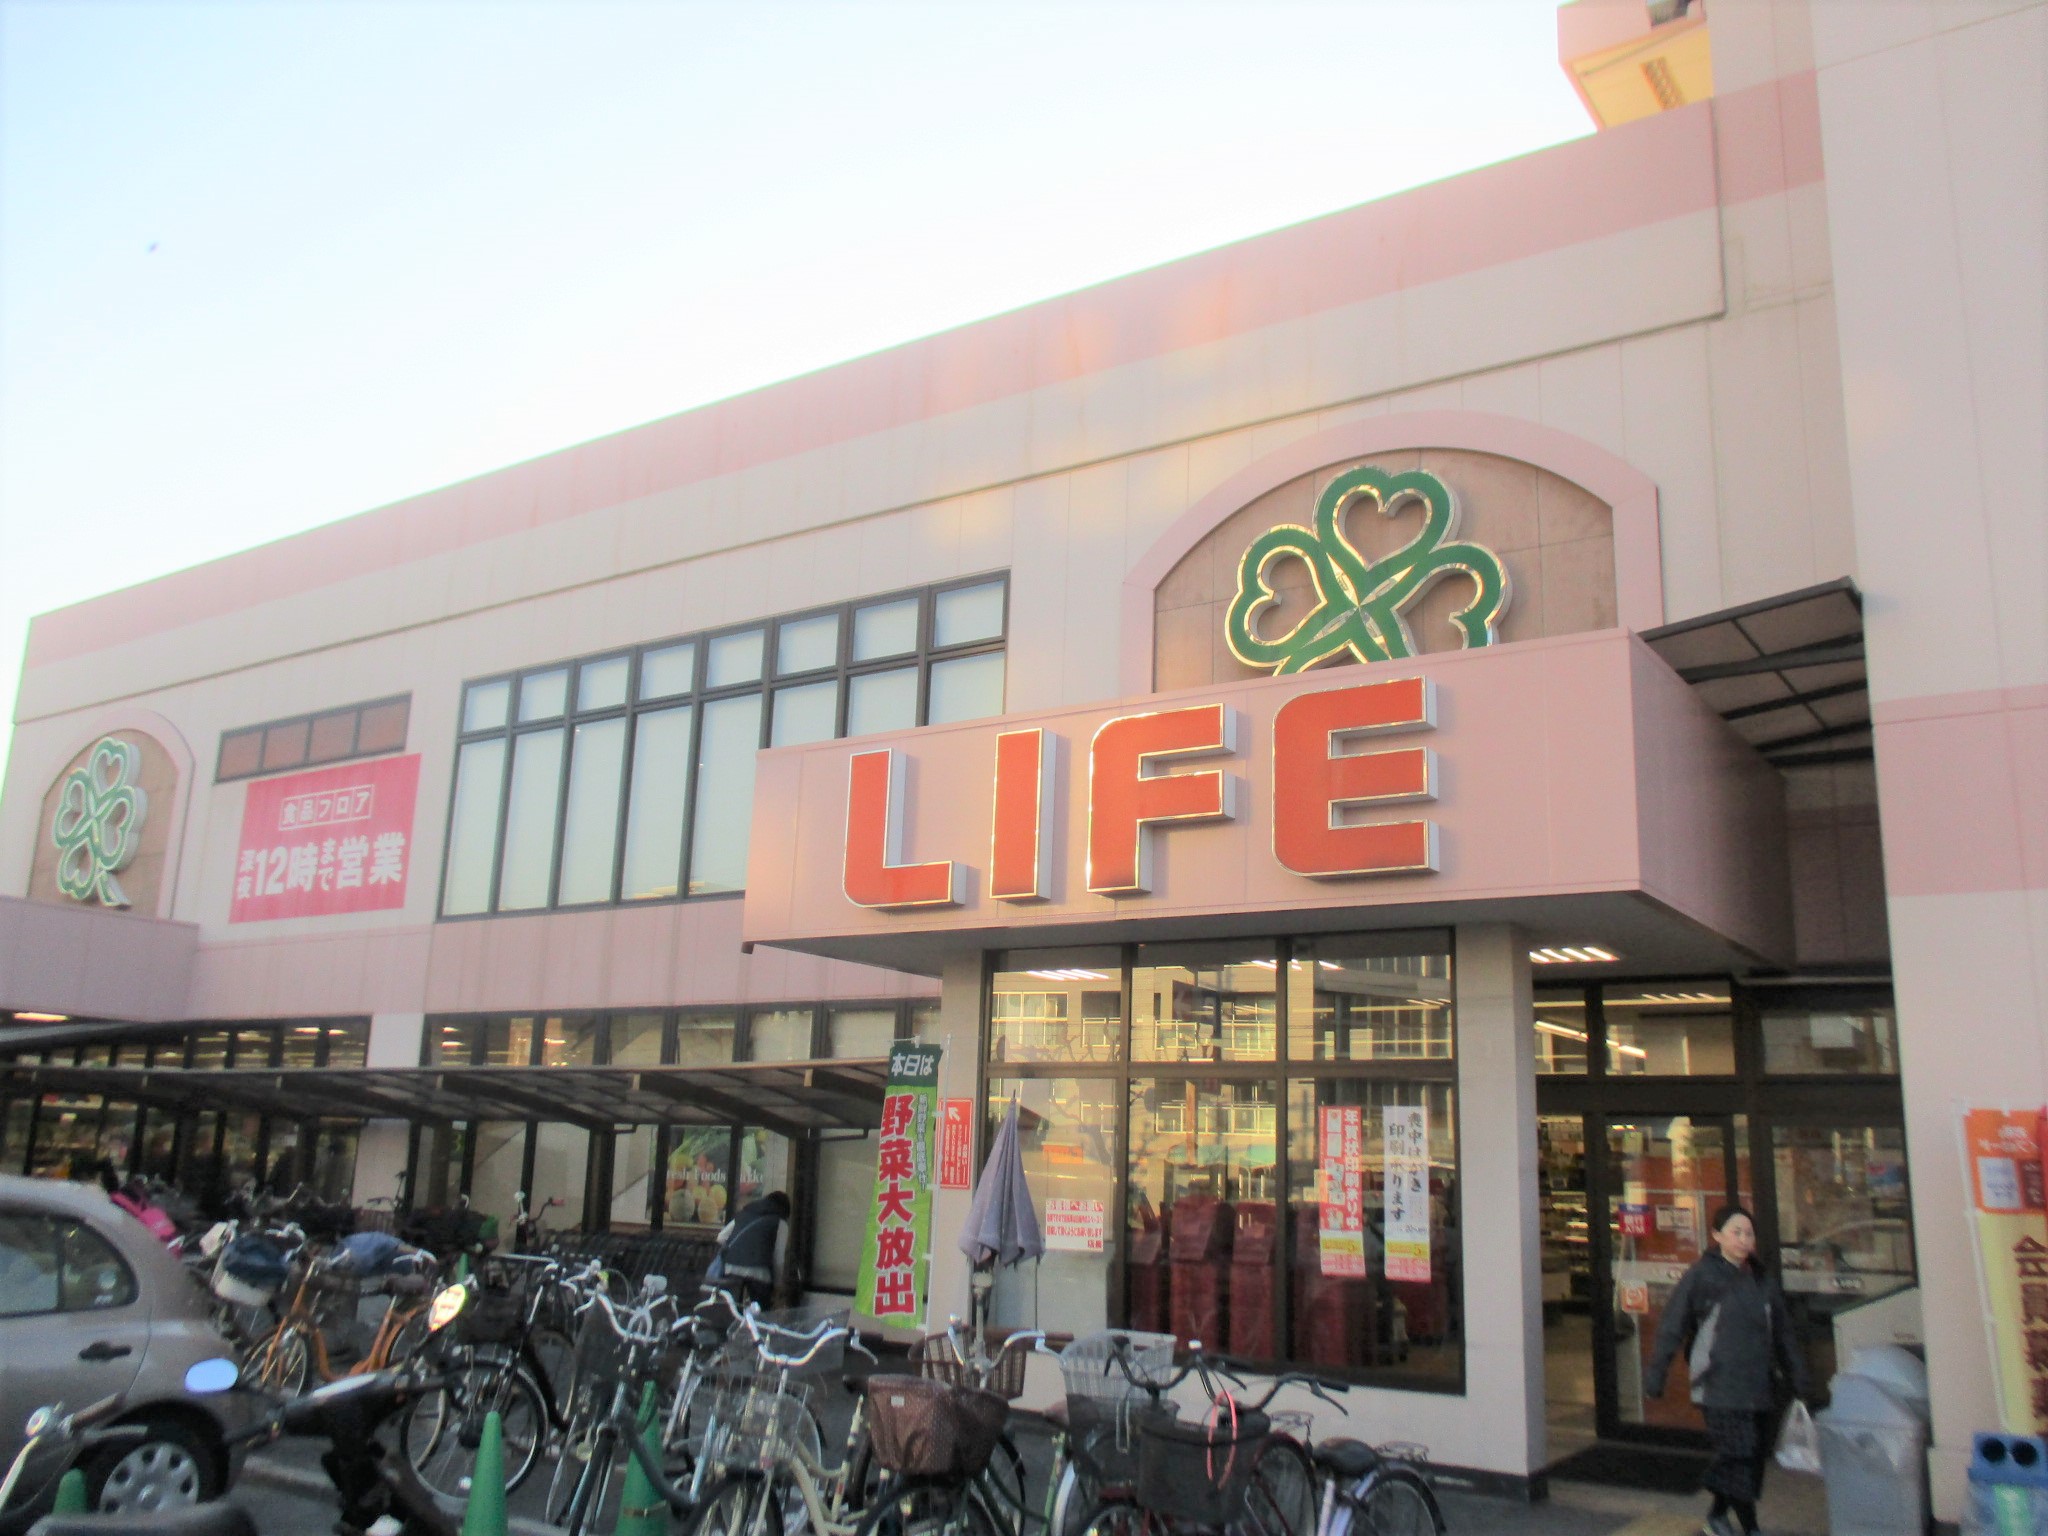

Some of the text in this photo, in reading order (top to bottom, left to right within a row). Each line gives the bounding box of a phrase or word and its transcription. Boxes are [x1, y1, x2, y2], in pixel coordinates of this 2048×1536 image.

[281, 790, 370, 825] 食品フロア
[843, 676, 1439, 909] LIFE
[891, 1053, 935, 1076] 本日は
[874, 1093, 916, 1316] 野菜大放出
